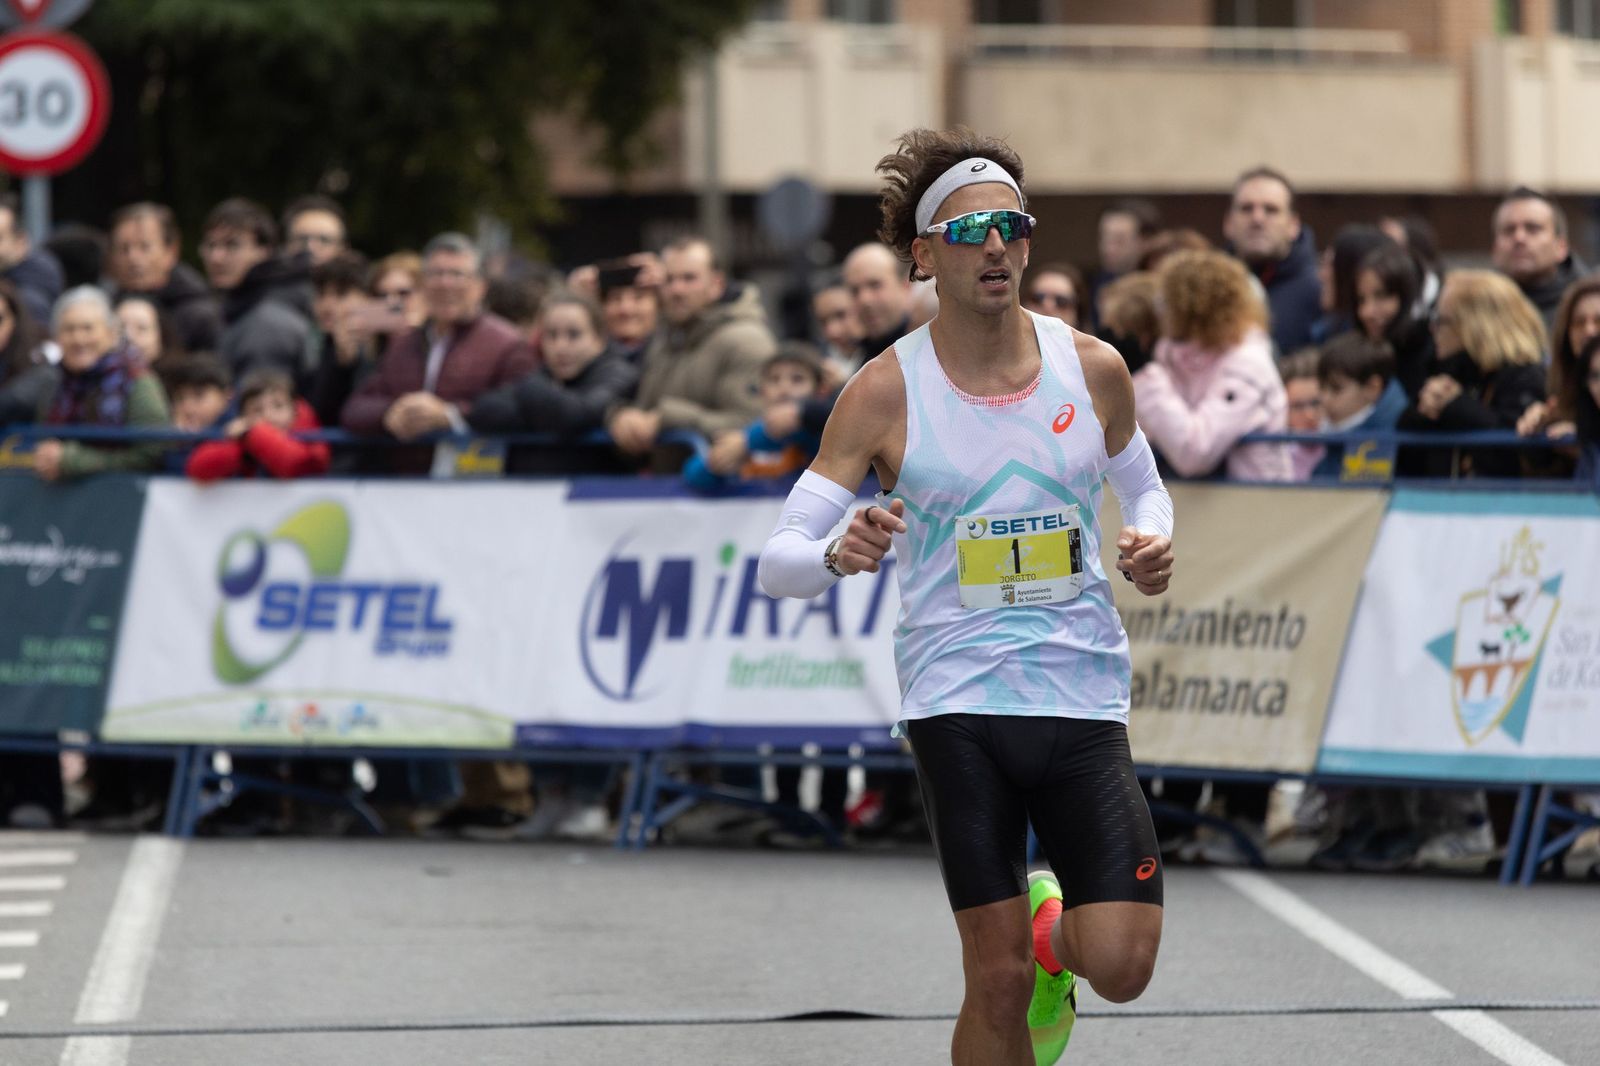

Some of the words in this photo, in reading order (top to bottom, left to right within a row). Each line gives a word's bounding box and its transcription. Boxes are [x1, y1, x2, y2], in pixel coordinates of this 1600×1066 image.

[0, 79, 73, 129] 30
[990, 513, 1070, 536] SETEL
[1010, 538, 1021, 574] 1
[999, 573, 1037, 584] JORGITO
[1017, 587, 1052, 597] Ayuntamiento
[1025, 595, 1053, 603] Salamanca
[256, 582, 453, 632] SETEL
